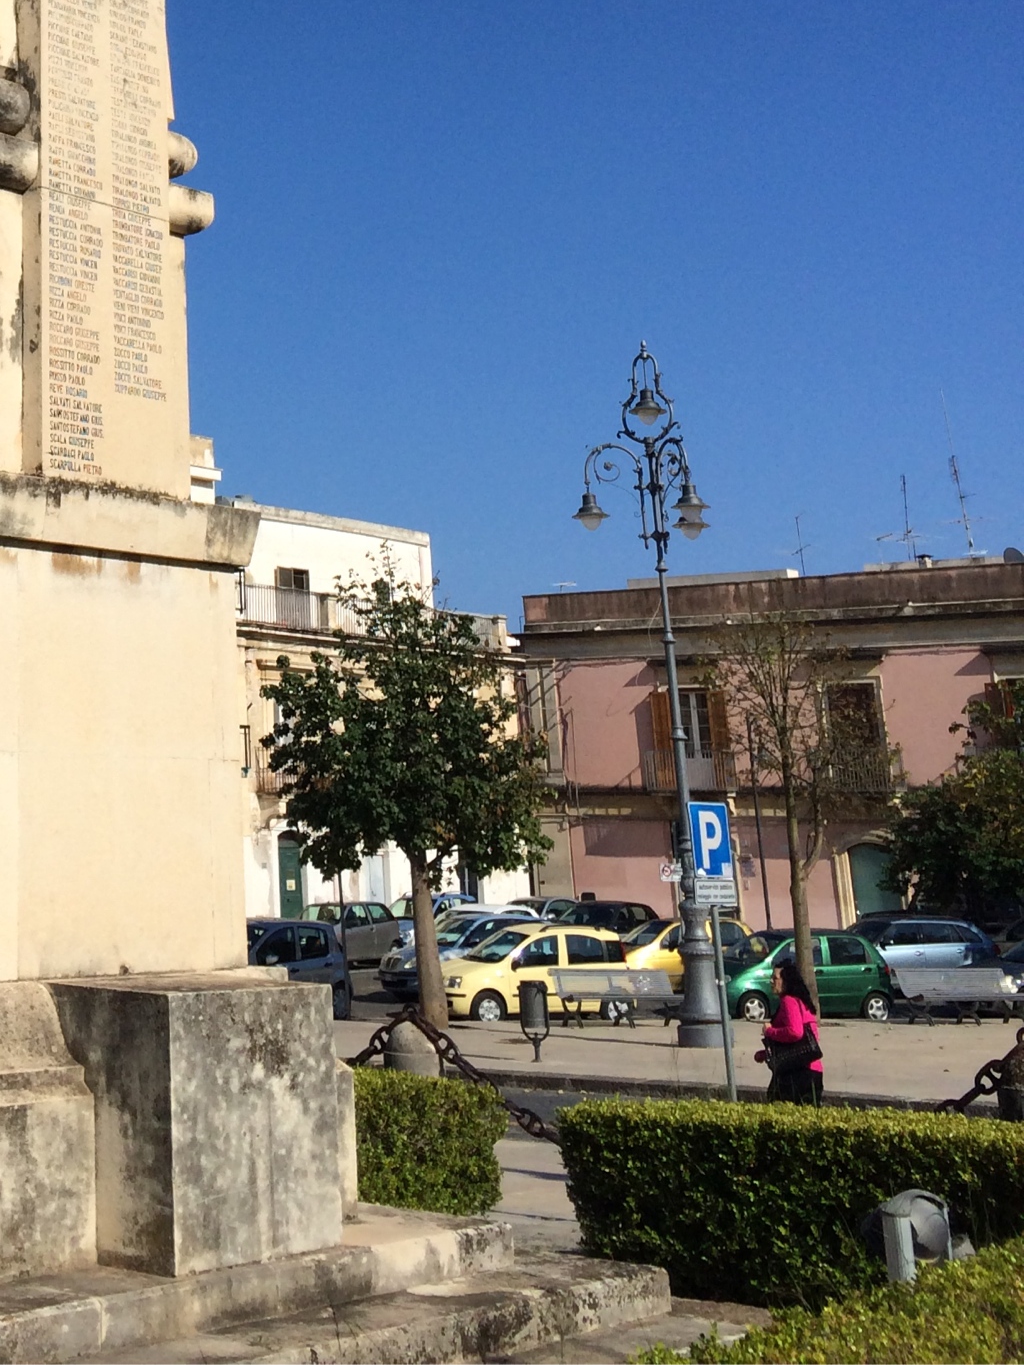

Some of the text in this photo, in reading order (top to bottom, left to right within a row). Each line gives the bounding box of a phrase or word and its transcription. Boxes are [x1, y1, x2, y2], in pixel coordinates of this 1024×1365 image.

[73, 162, 95, 177] CORRADO
[73, 174, 103, 190] FRANCESCO
[68, 208, 87, 221] ANGELO
[80, 233, 103, 248] CORRADO
[67, 289, 86, 302] ANGELO
[66, 301, 90, 315] CORRADO
[66, 313, 83, 325] PAOLO
[76, 351, 100, 365] CORRADO
[76, 363, 92, 375] PAOLO
[68, 374, 85, 386] PAOLO
[72, 398, 102, 413] SALVATORE
[49, 432, 94, 449] SCALA GIUSEPPE
[77, 449, 94, 461] PAOLO
[698, 810, 723, 869] P
